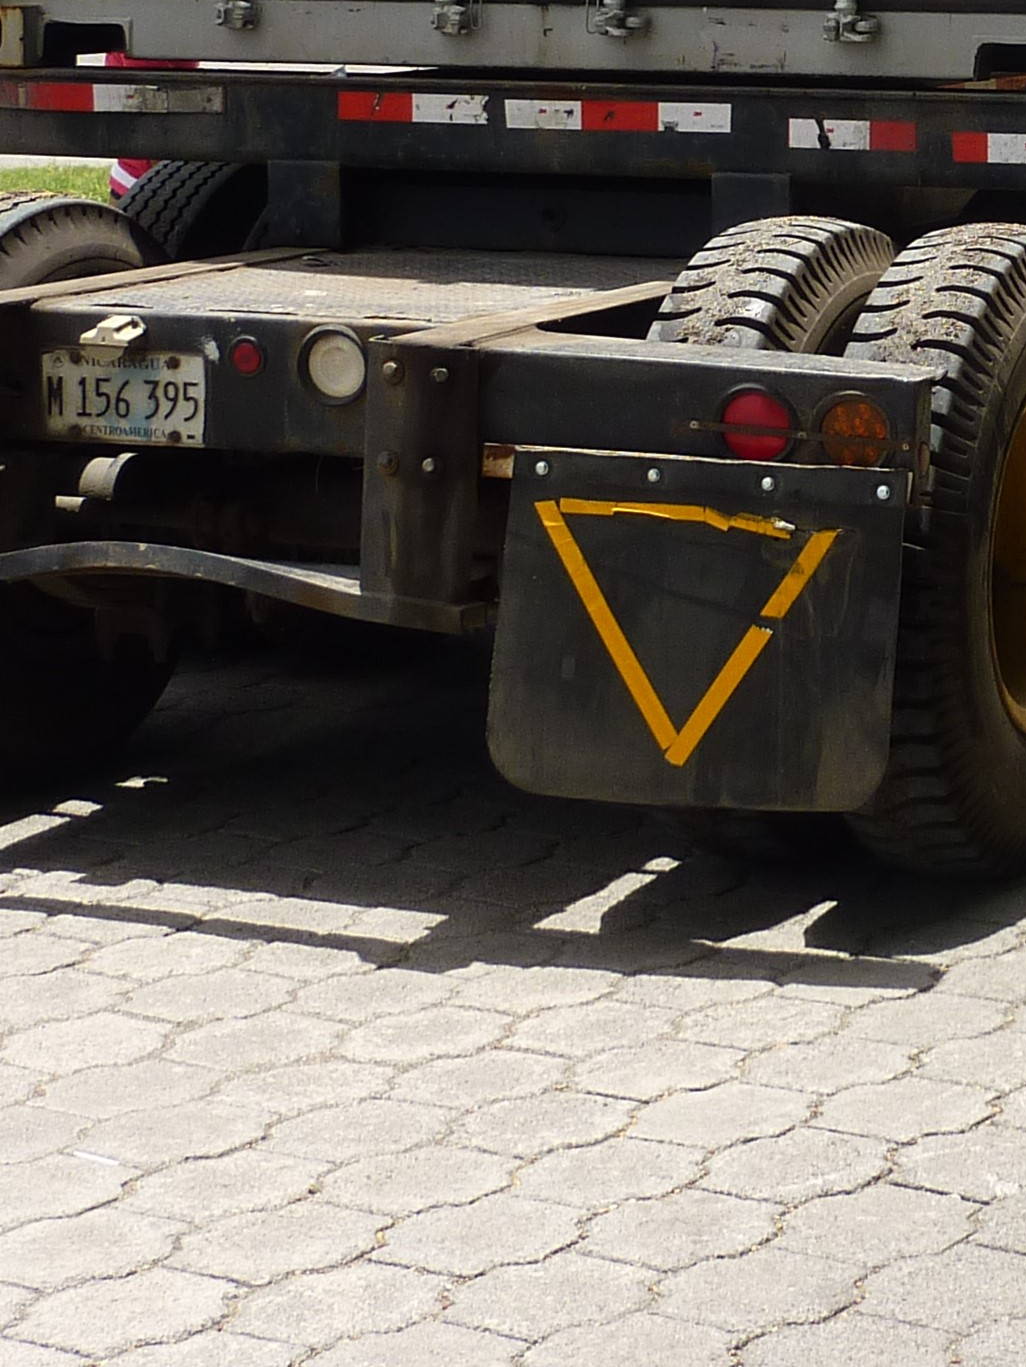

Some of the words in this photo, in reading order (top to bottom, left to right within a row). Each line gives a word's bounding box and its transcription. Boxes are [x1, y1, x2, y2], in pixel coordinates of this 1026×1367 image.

[46, 375, 64, 417] M
[76, 376, 131, 419] 156
[143, 379, 199, 422] 395
[81, 424, 167, 439] CENTROAMERICA
